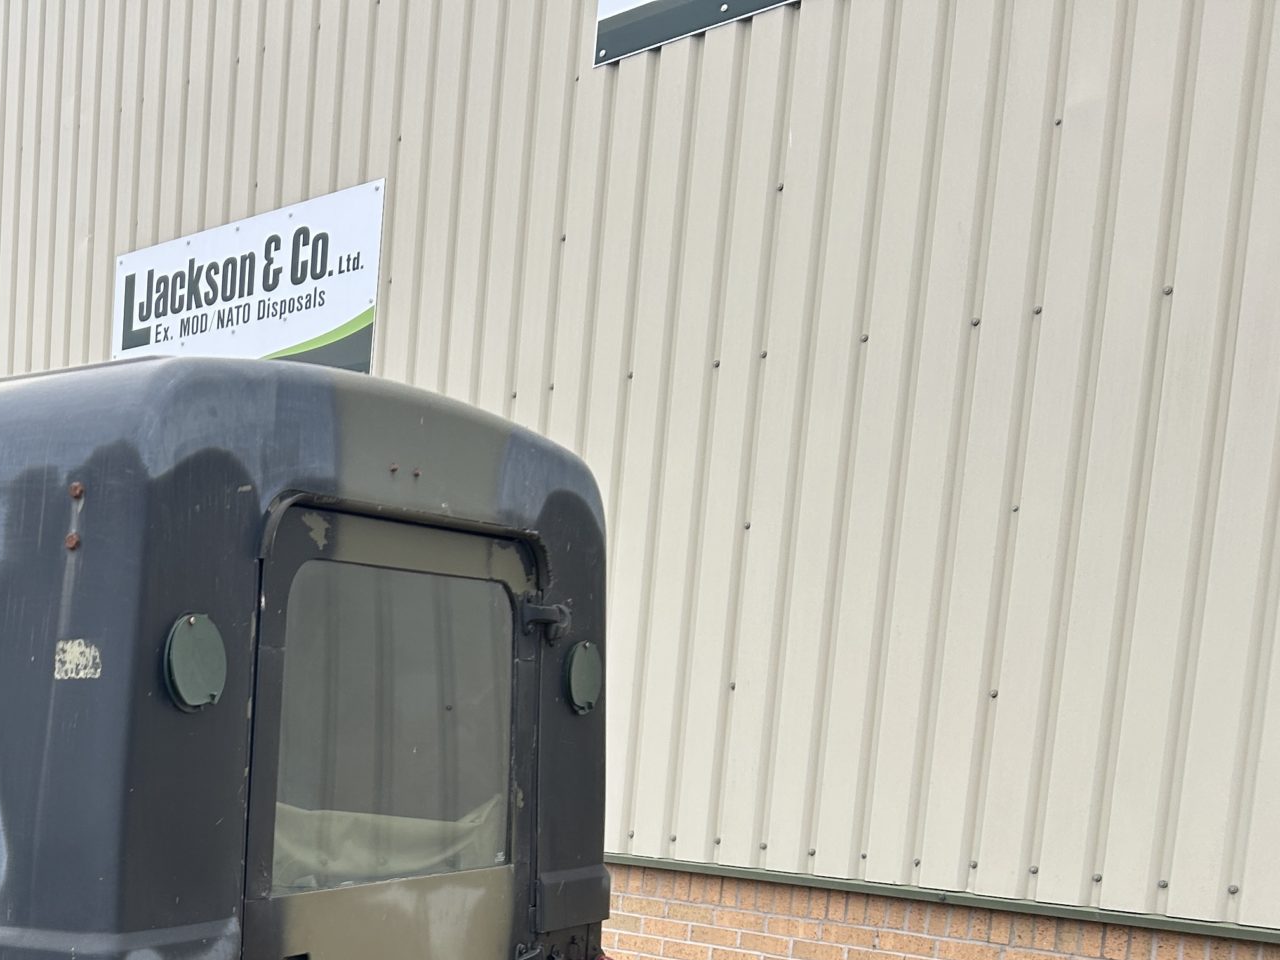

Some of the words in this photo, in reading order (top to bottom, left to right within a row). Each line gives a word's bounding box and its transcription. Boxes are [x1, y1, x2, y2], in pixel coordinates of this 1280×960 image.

[262, 234, 283, 292] &
[290, 226, 333, 286] Co.
[338, 252, 364, 275] Ltd.
[155, 323, 174, 344] Ex.
[257, 287, 326, 321] Disposals
